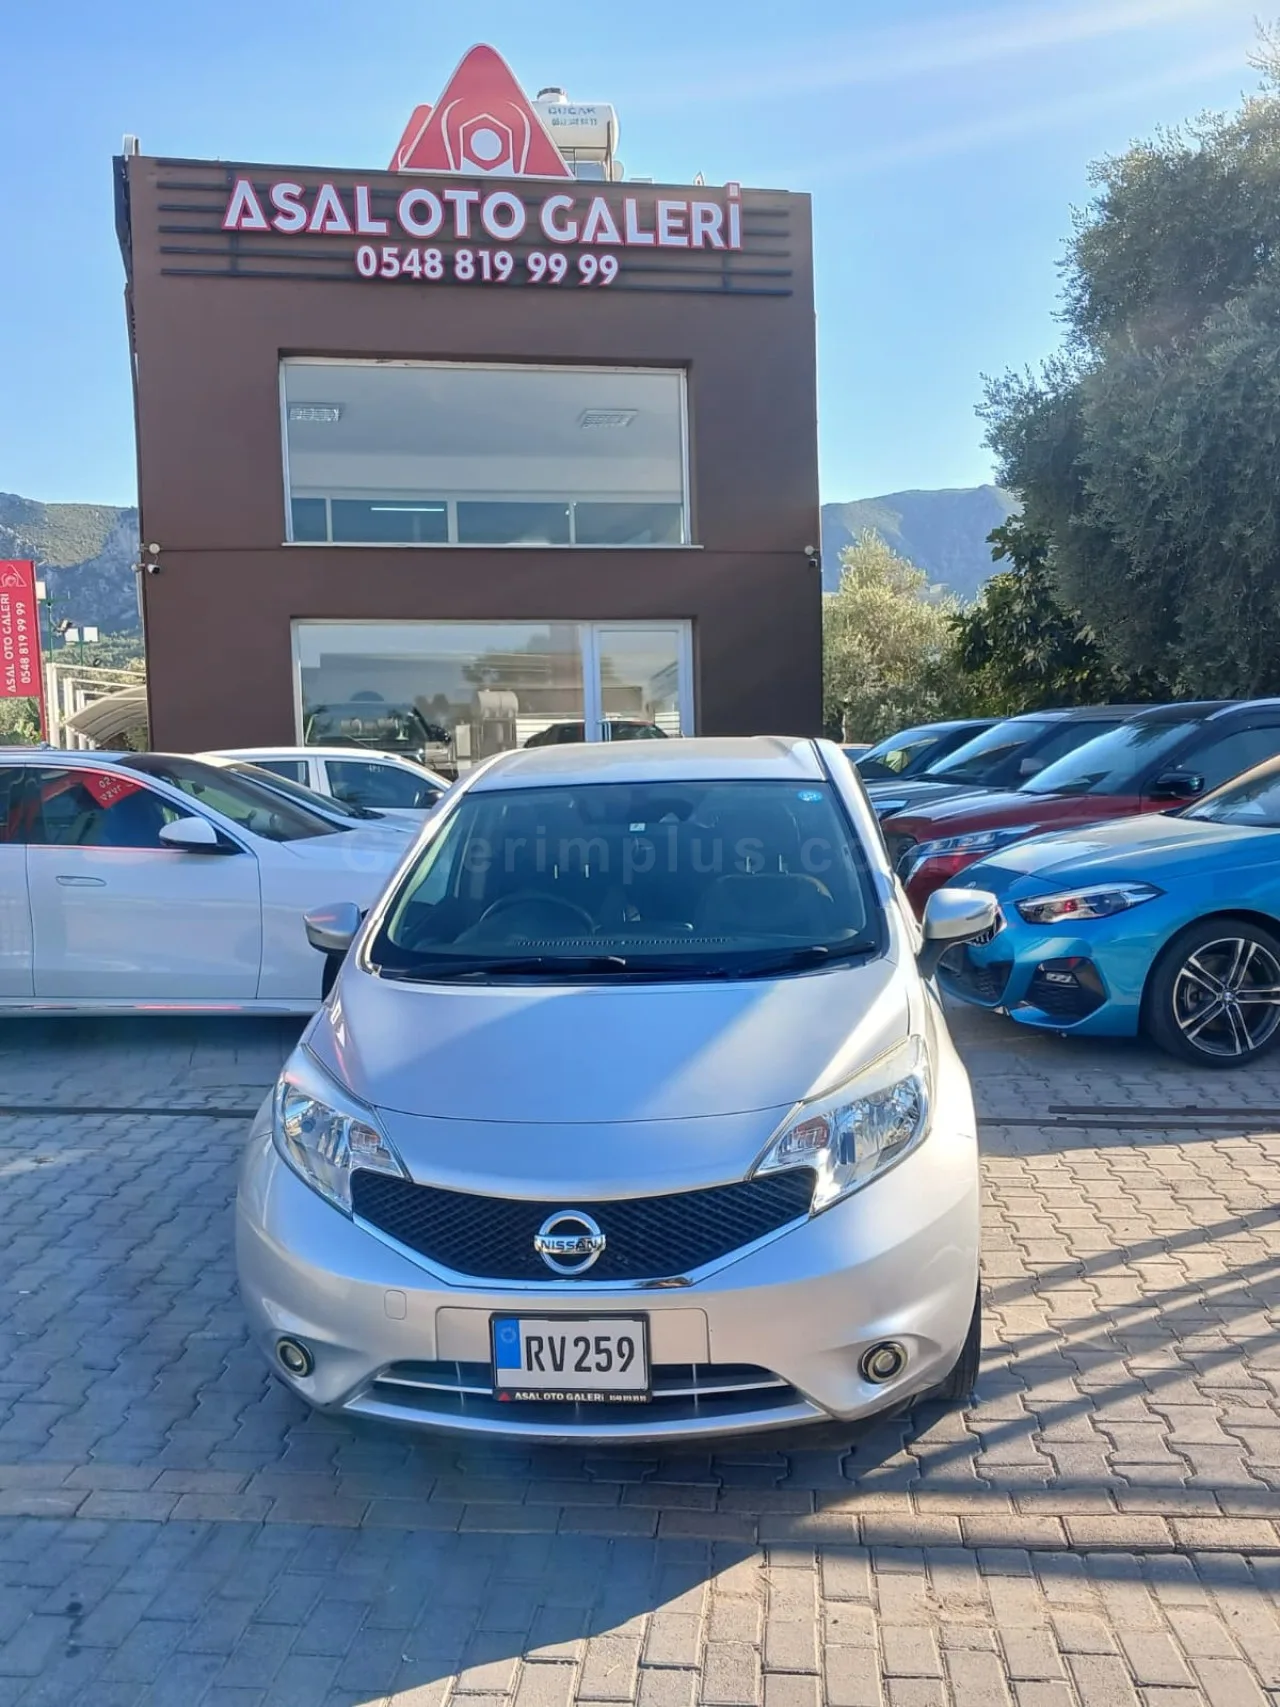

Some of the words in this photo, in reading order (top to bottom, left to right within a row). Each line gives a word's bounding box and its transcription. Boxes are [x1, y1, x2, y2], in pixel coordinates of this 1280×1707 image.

[222, 177, 389, 235] ASAL
[396, 188, 526, 241] OTO
[540, 182, 742, 251] GALERİ
[356, 245, 444, 281] 0548
[454, 248, 514, 282] 819
[526, 252, 567, 285] 99
[578, 254, 619, 287] 99
[16, 602, 25, 614] 99
[17, 618, 27, 631] 99
[3, 637, 13, 659] OTO
[18, 635, 29, 654] 819
[6, 663, 16, 692] ASAL
[20, 657, 30, 683] 0548
[541, 1238, 597, 1250] NISSAN
[514, 1391, 543, 1401] ASAL
[543, 1392, 564, 1401] OTO
